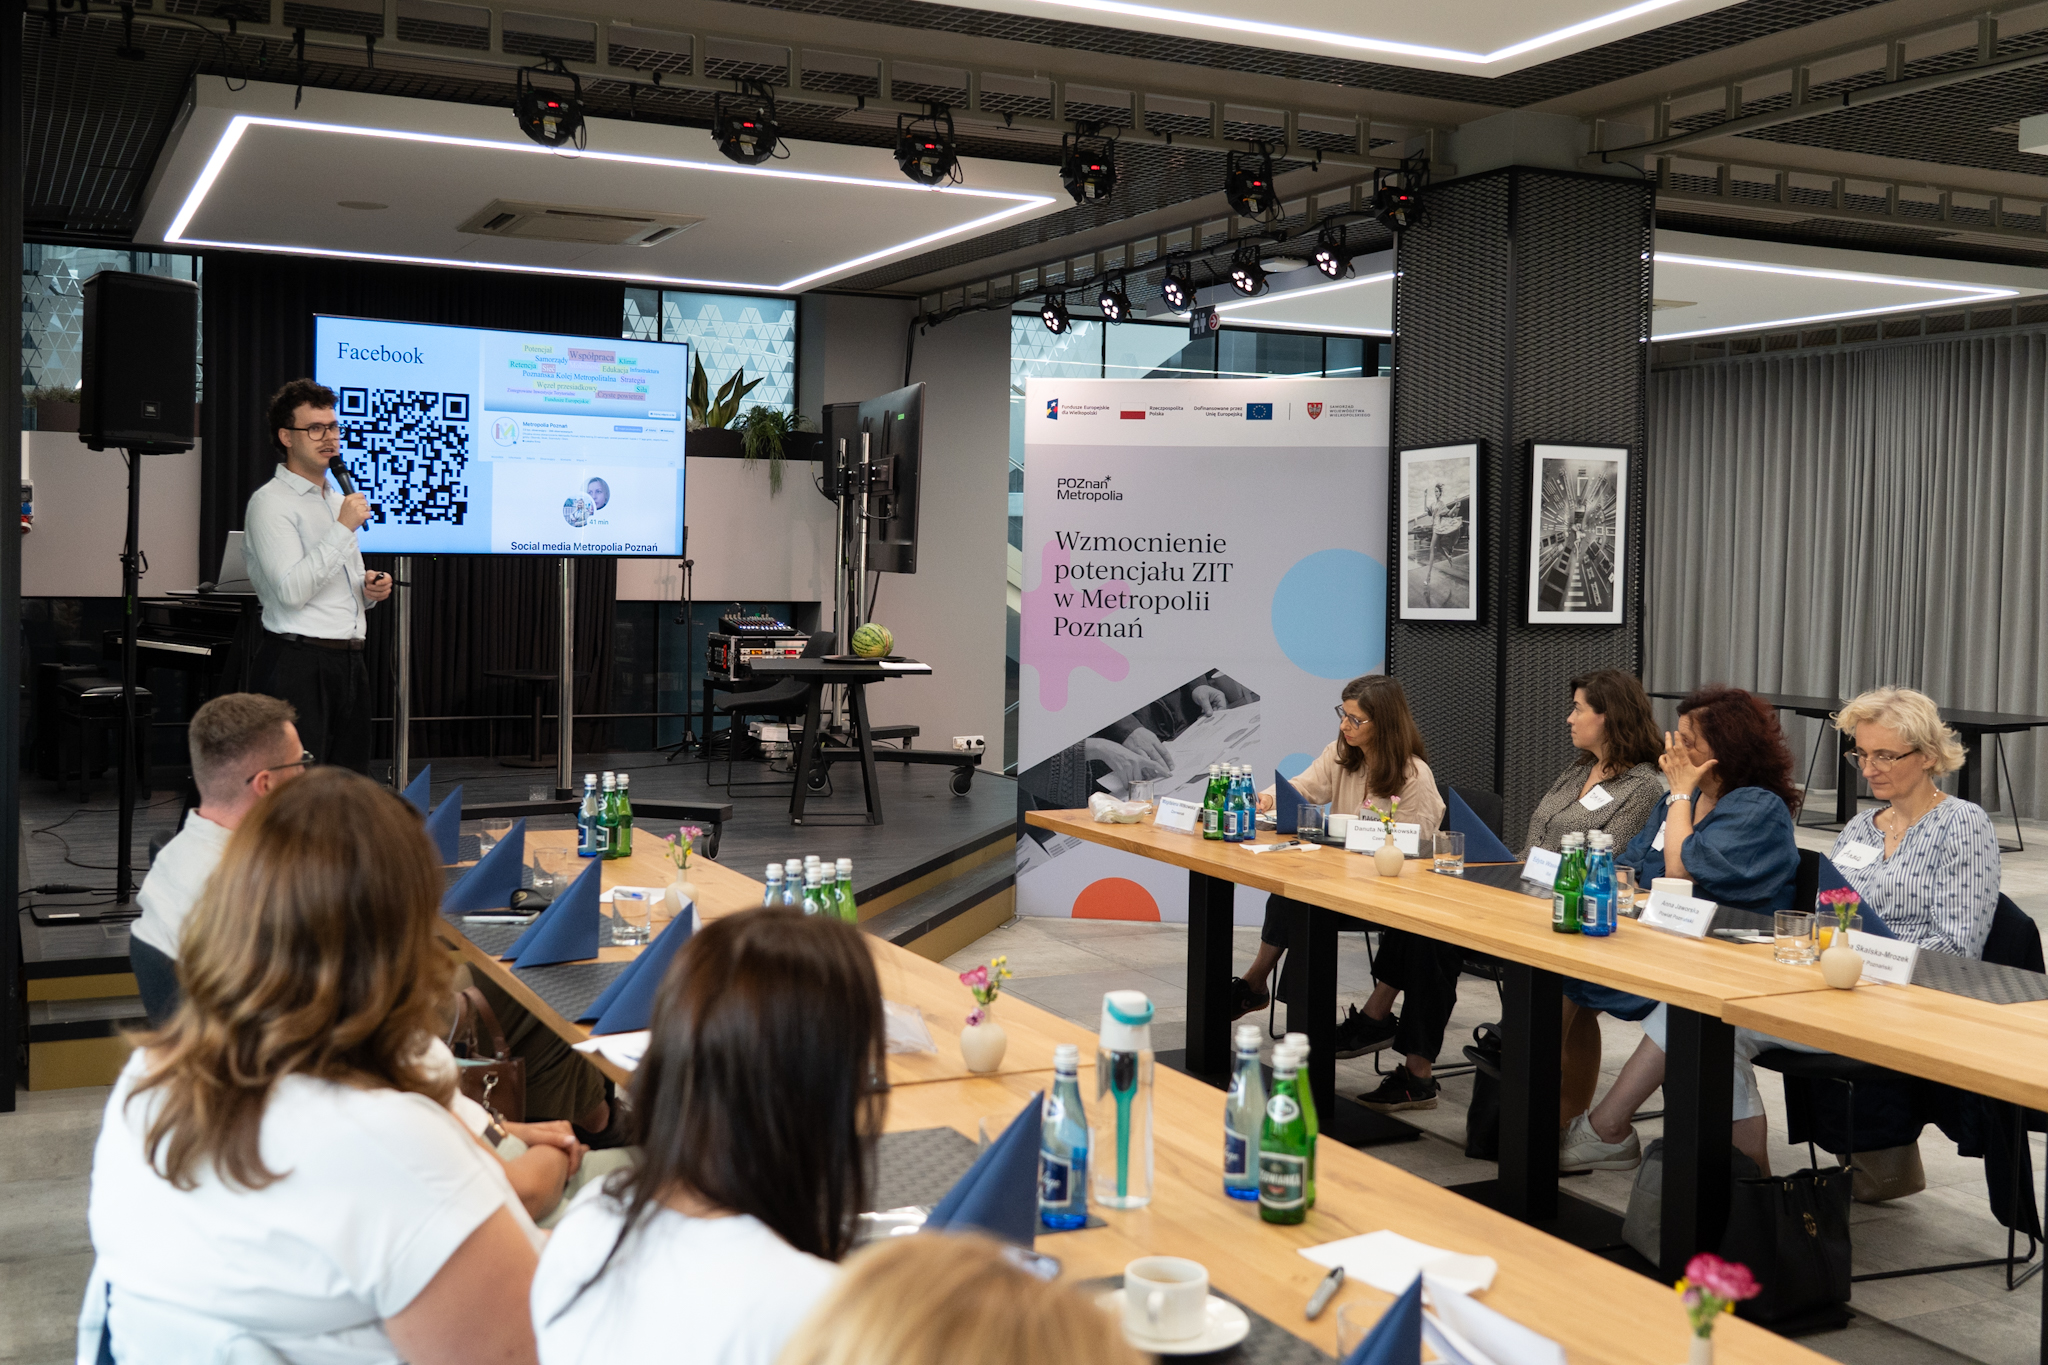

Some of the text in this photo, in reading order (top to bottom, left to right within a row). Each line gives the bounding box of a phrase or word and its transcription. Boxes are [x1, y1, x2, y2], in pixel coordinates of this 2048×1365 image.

[337, 342, 424, 364] Facebook
[570, 351, 614, 362] Współpraca
[510, 360, 537, 370] Retencja
[535, 355, 568, 365] Samorządy
[602, 366, 629, 374] Edukacja
[556, 372, 573, 381] Kolej
[574, 373, 616, 382] Metropolitalna
[620, 376, 646, 385] Strategia
[557, 383, 598, 392] przesiadkowy
[597, 391, 616, 399] Czyste
[1057, 489, 1123, 502] Metropolia
[511, 541, 658, 553] Social media Metropolia Poznań
[1054, 531, 1227, 553] Wzmocnienie
[1054, 561, 1234, 586] potencjału ZIT
[1054, 588, 1210, 614] w Metropolii
[1053, 616, 1144, 638] Poznań
[1661, 900, 1700, 914] Anna Jaworska
